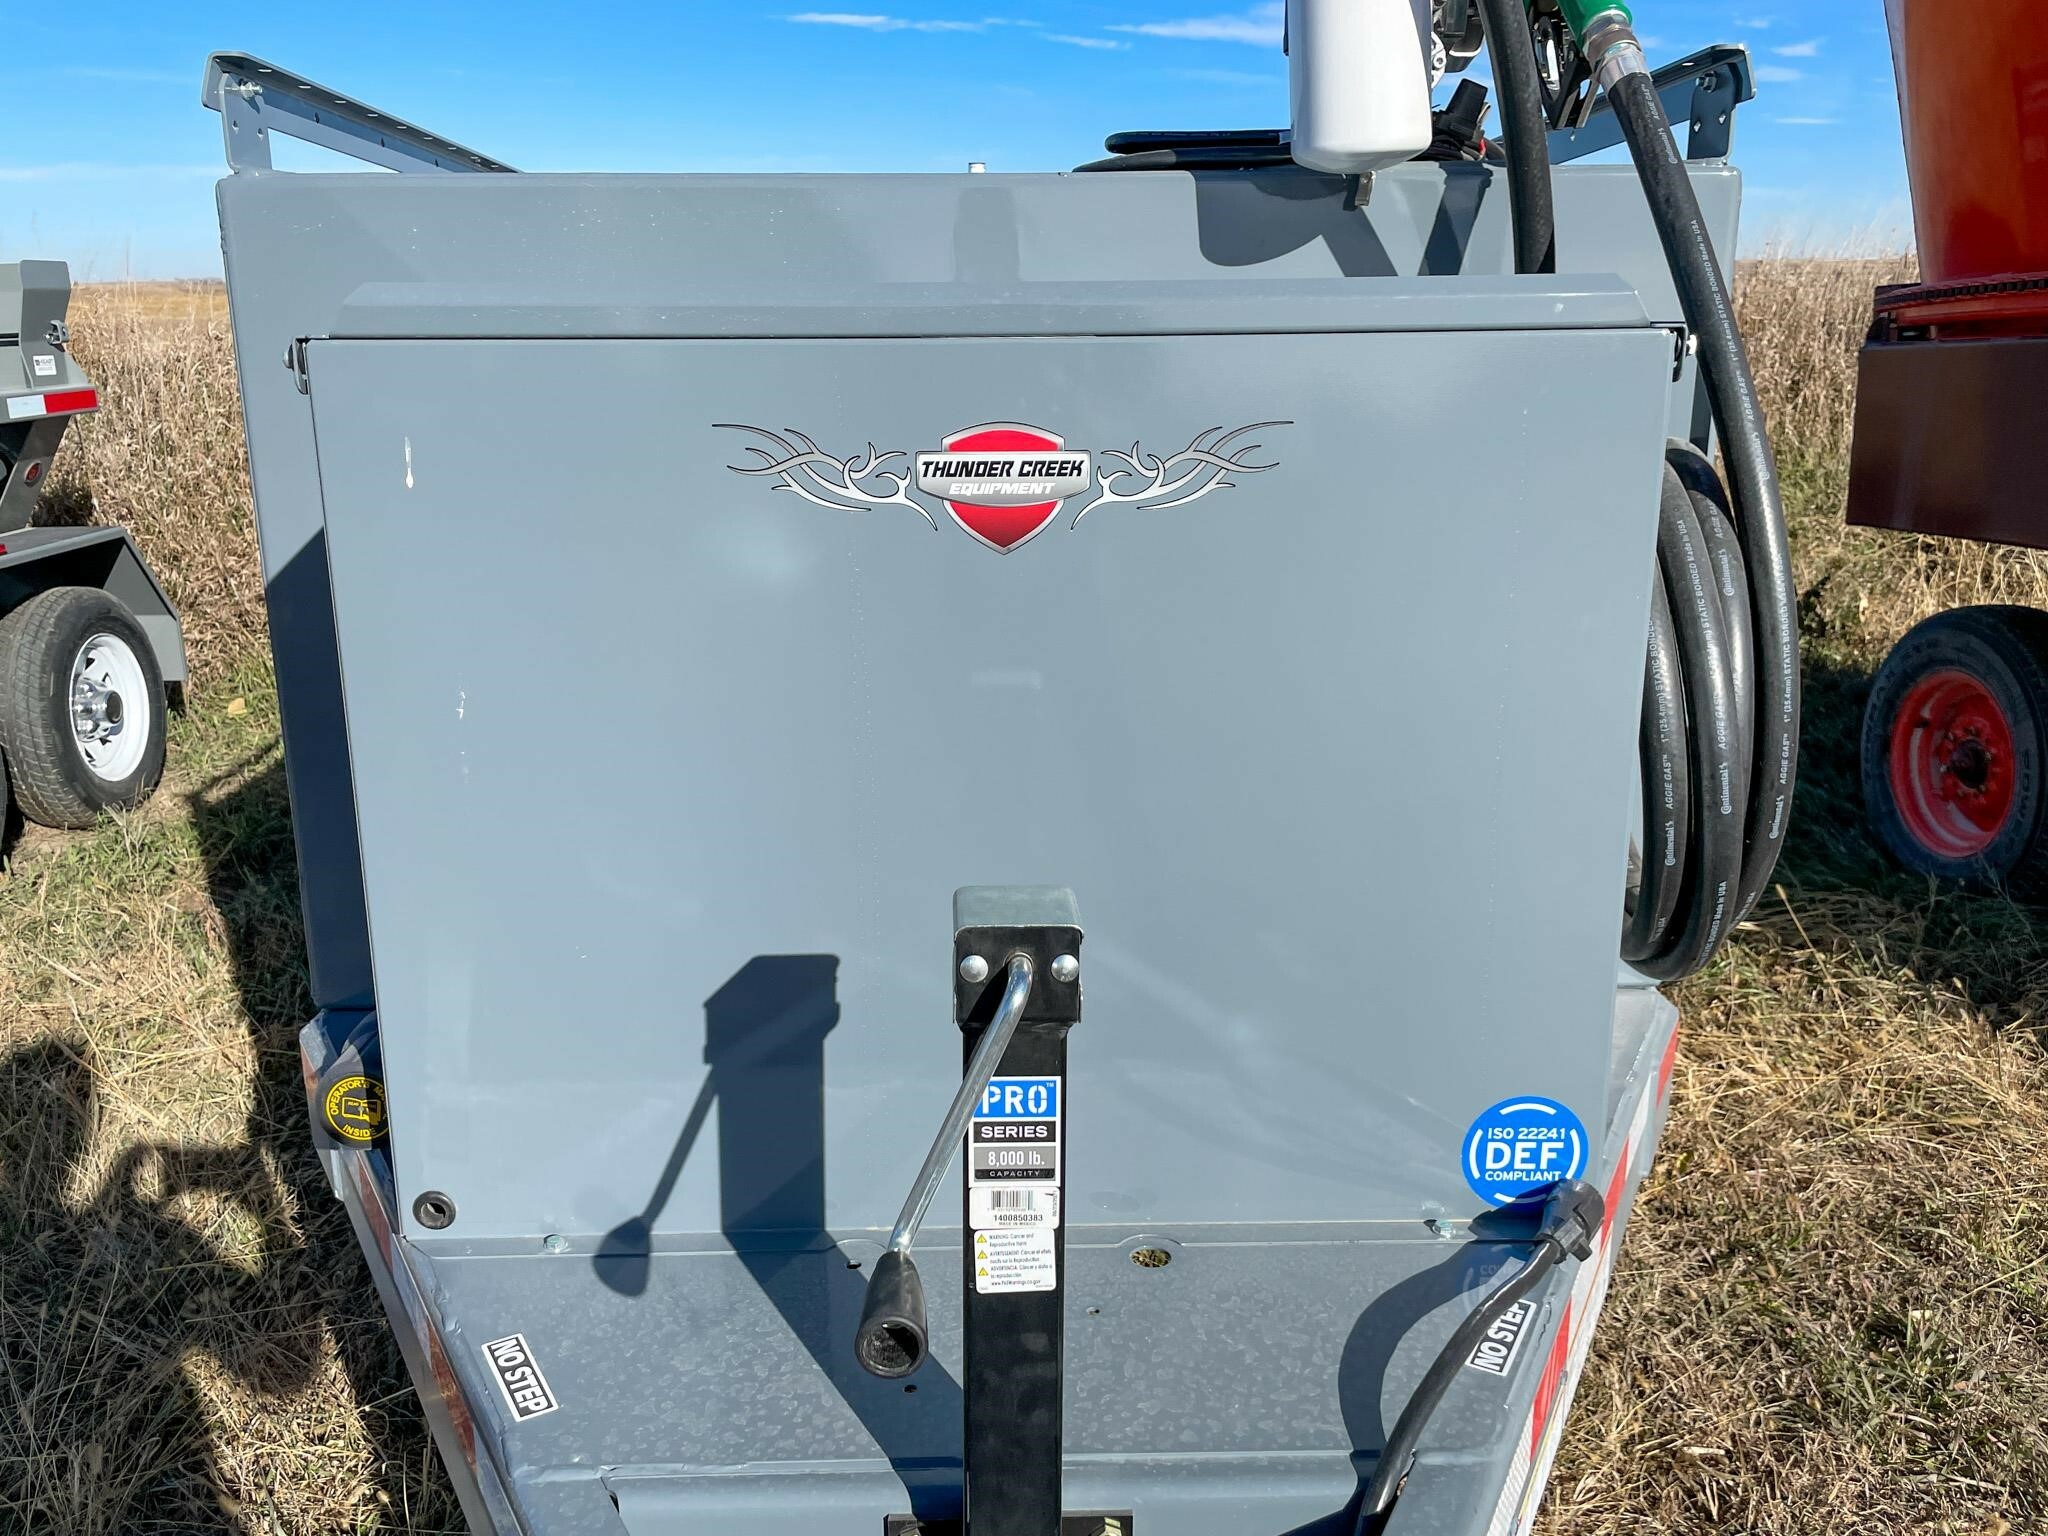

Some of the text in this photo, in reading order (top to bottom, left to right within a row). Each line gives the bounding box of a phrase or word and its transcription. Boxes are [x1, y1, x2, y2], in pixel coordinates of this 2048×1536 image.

[1690, 219, 1700, 234] USA
[921, 459, 1085, 478] THUNDER CREEK
[949, 482, 1056, 497] EQUIPMENT
[1676, 520, 1688, 534] USA
[1689, 563, 1703, 597] BONDED
[1697, 598, 1710, 628] STATIC
[1780, 606, 1789, 641] BONDED
[1783, 643, 1792, 675] STATIC
[1651, 660, 1664, 691] STATIC
[1664, 782, 1673, 810] AGGIE
[1718, 881, 1727, 897] USA
[343, 1124, 377, 1137] INSIDE
[981, 1125, 1048, 1138] SERIES
[1488, 1127, 1565, 1139] ISO 22241
[988, 1150, 1045, 1167] 8,000 lb.
[1485, 1142, 1564, 1169] DEF
[1485, 1171, 1561, 1181] COMPLIANT
[1473, 1341, 1508, 1371] NO
[490, 1338, 548, 1411] NO STEP
